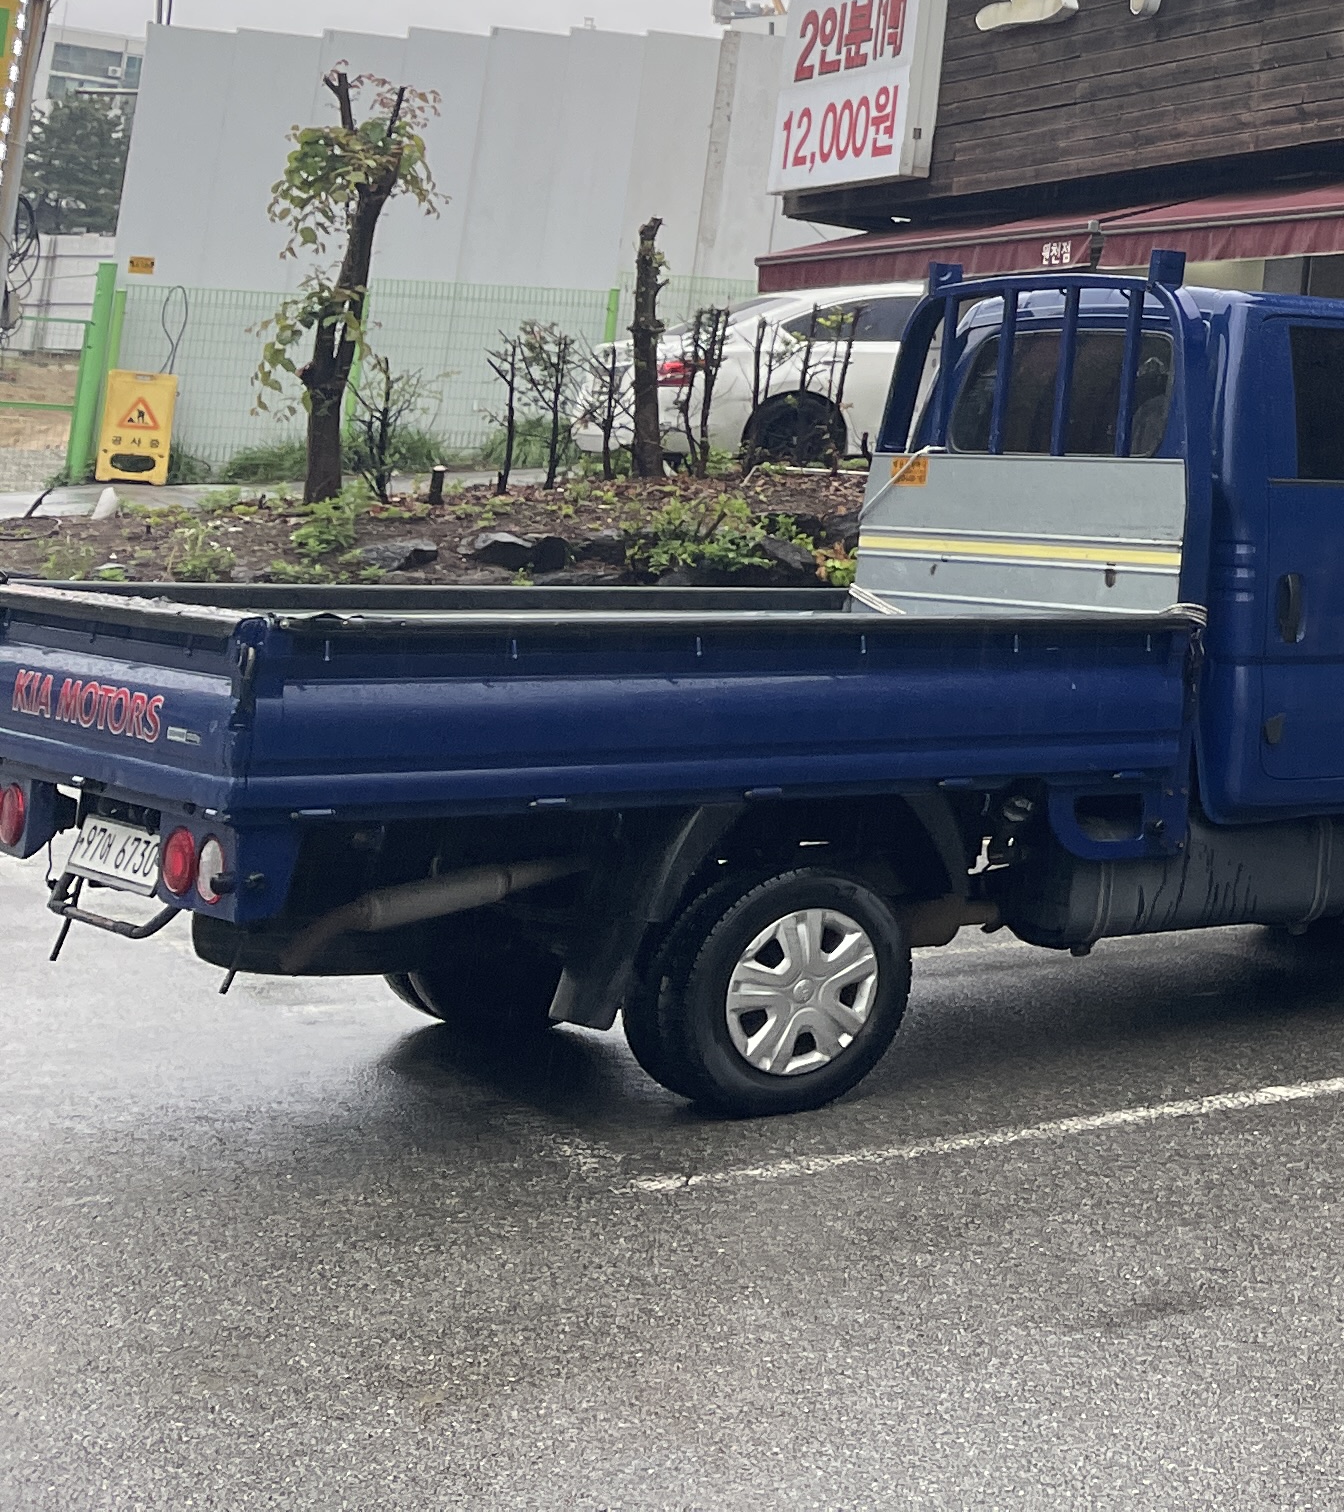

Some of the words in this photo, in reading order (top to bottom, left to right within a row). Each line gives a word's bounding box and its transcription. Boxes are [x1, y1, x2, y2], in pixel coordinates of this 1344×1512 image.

[782, 85, 899, 173] 12,000원
[1042, 240, 1071, 265] 원천점
[12, 669, 54, 718] KIA
[55, 678, 165, 743] MOTORS
[114, 835, 160, 877] 6730
